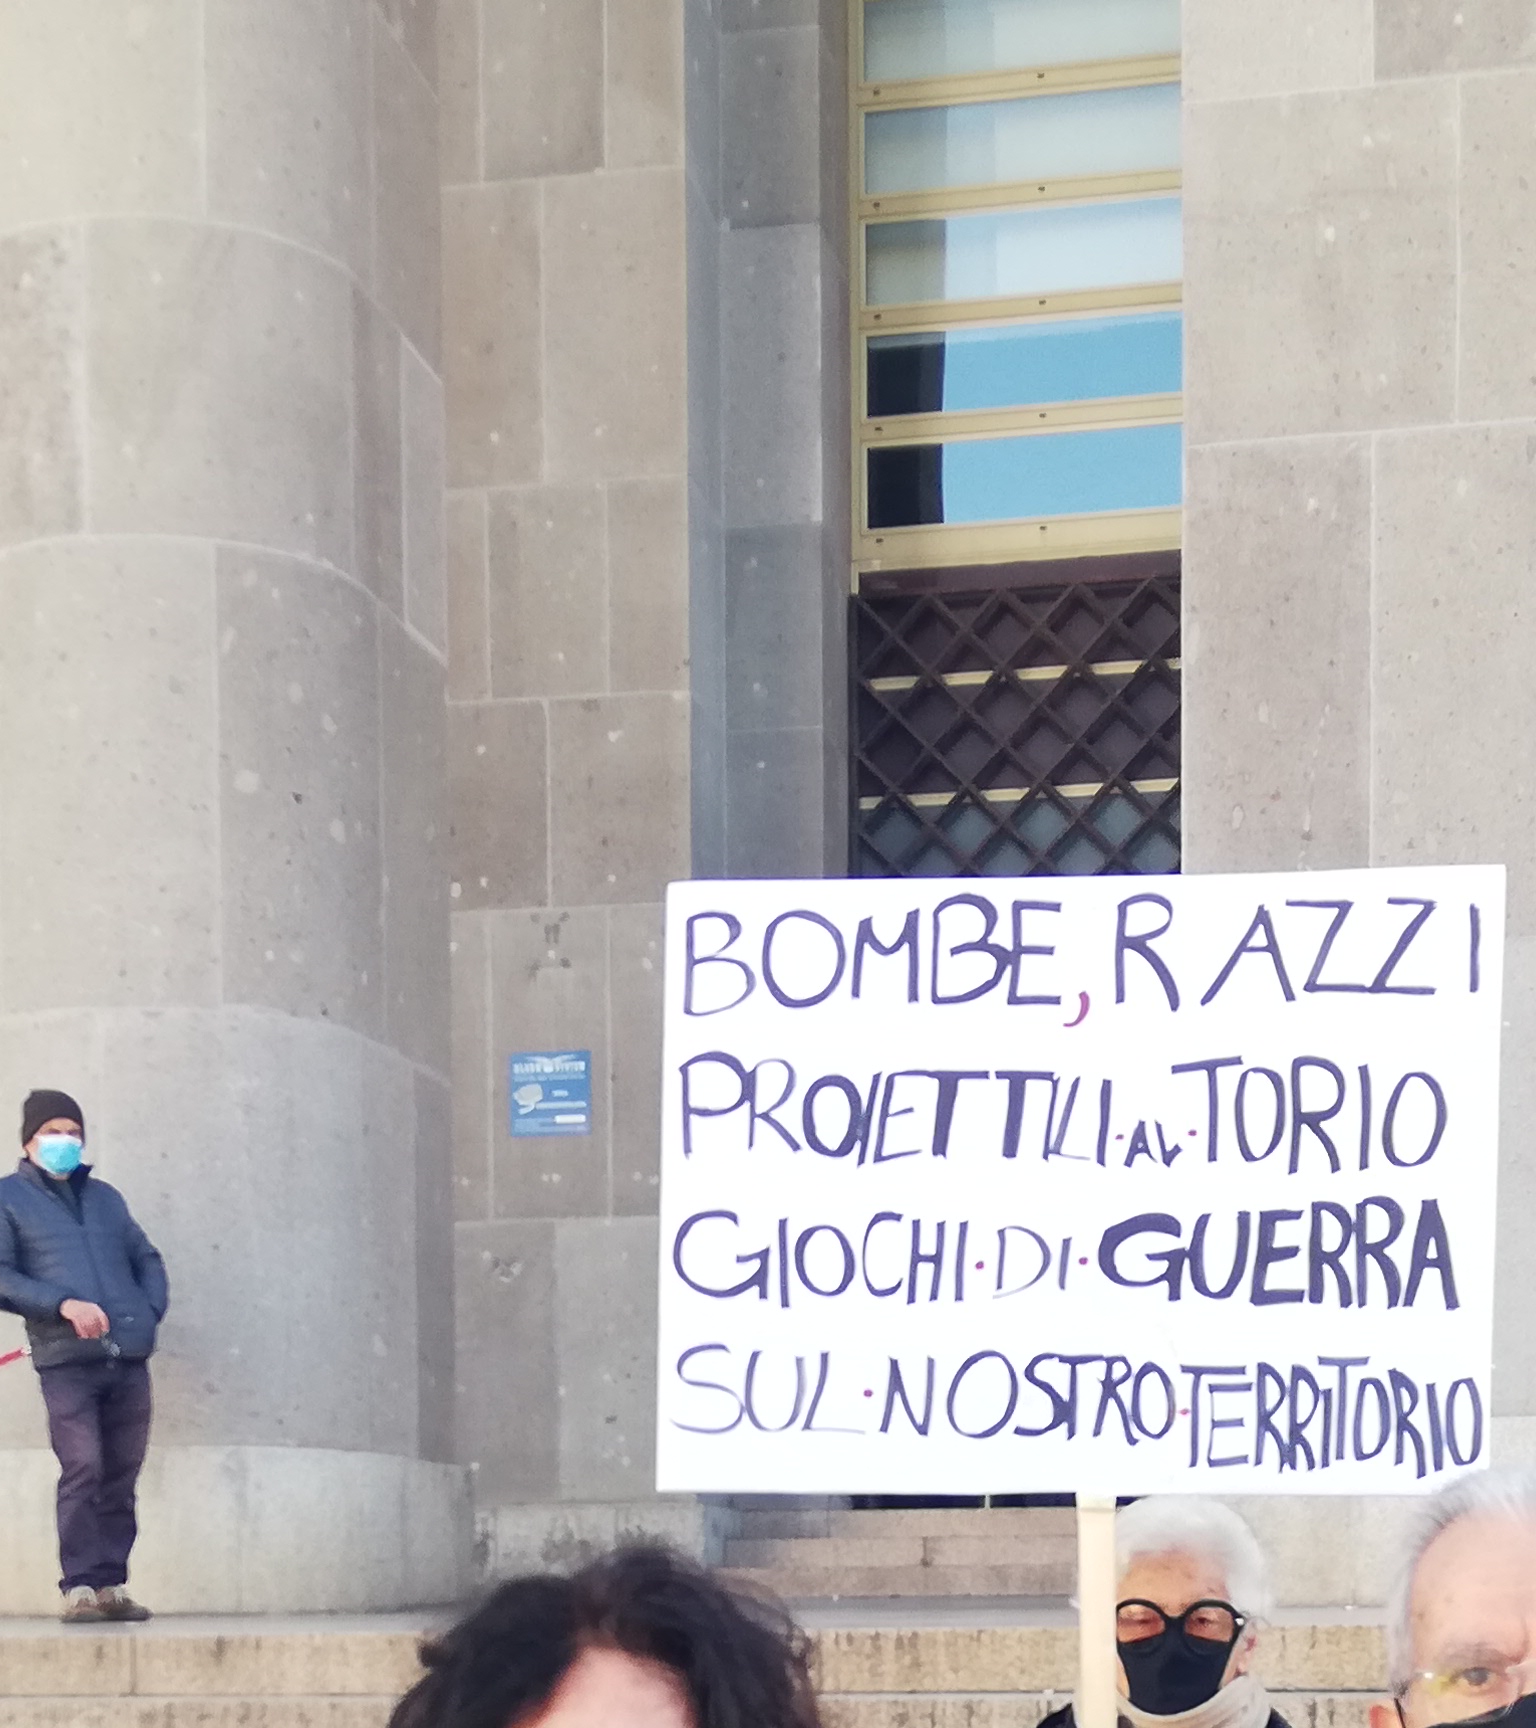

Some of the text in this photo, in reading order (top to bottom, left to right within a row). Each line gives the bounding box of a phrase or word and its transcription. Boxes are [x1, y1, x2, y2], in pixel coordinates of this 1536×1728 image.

[1114, 891, 1481, 1012] RAZZI
[1171, 1055, 1448, 1175] TORIO
[672, 1195, 1460, 1311] GIOCHI DI GUERRA
[668, 1342, 1483, 1479] SUL NOSTRO TERRITORIO
